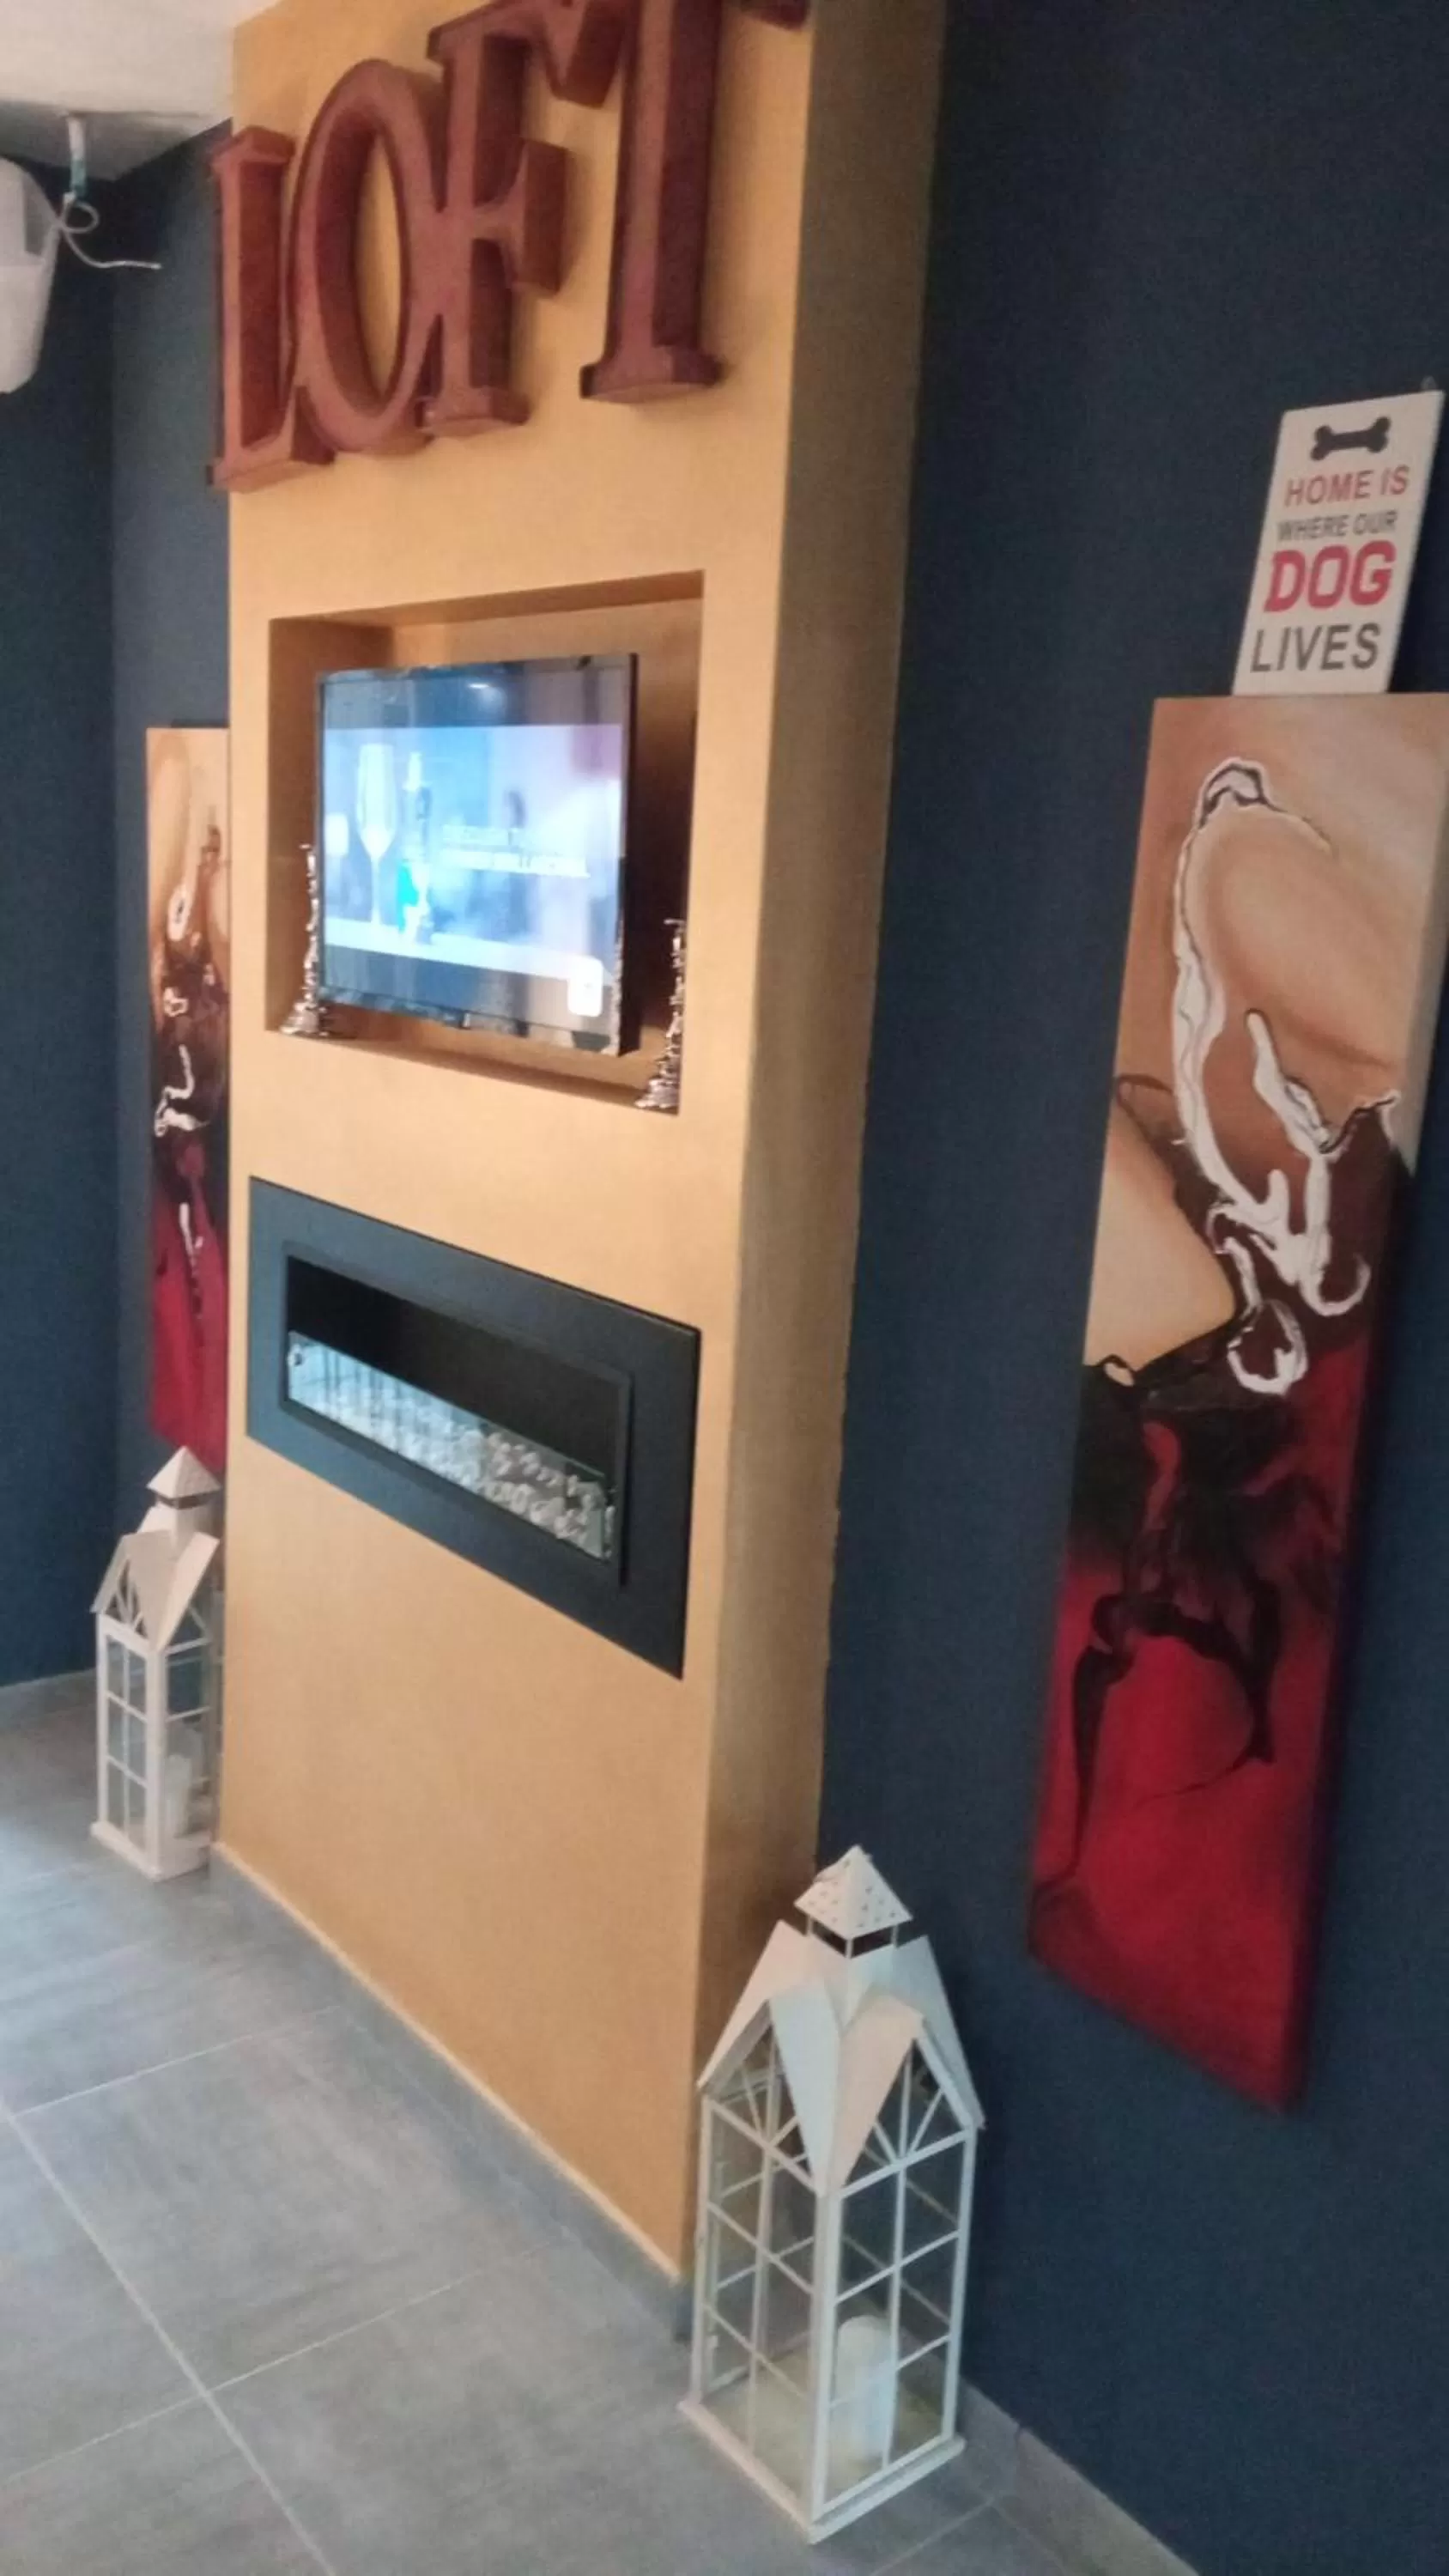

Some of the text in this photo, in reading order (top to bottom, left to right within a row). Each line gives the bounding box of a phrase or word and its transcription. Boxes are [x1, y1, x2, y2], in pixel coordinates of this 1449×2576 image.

[207, 0, 809, 492] LOFT
[1285, 465, 1410, 507] HOME IS
[1278, 511, 1398, 541] WHERE OUR
[1264, 540, 1397, 613] DOG
[1250, 623, 1381, 673] LIVES
